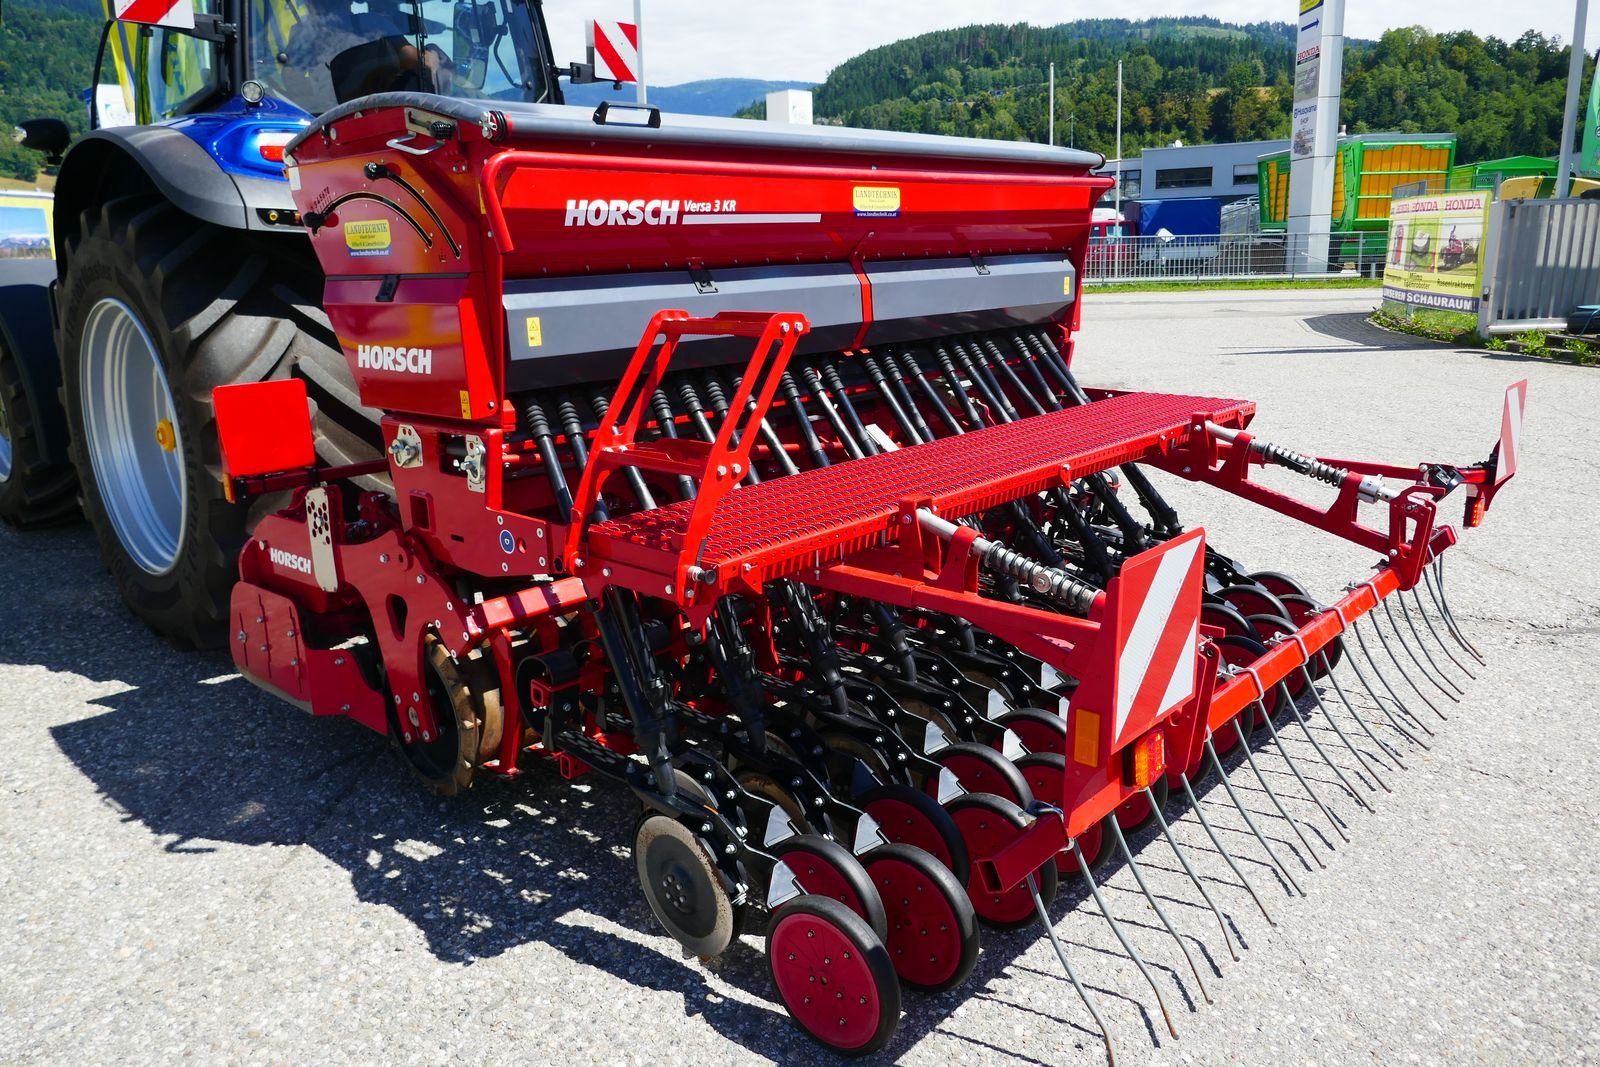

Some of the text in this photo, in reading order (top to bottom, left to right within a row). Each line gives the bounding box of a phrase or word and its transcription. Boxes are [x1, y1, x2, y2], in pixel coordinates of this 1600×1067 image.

[1297, 45, 1320, 60] HONDA
[856, 189, 898, 199] LANDTECHNIK
[1445, 199, 1481, 210] HONDA
[564, 199, 737, 226] HORSCH Versa 3 KR
[346, 223, 388, 234] LANDTECHNIK
[358, 345, 432, 375] HORSCH
[270, 547, 312, 575] HORSCH
